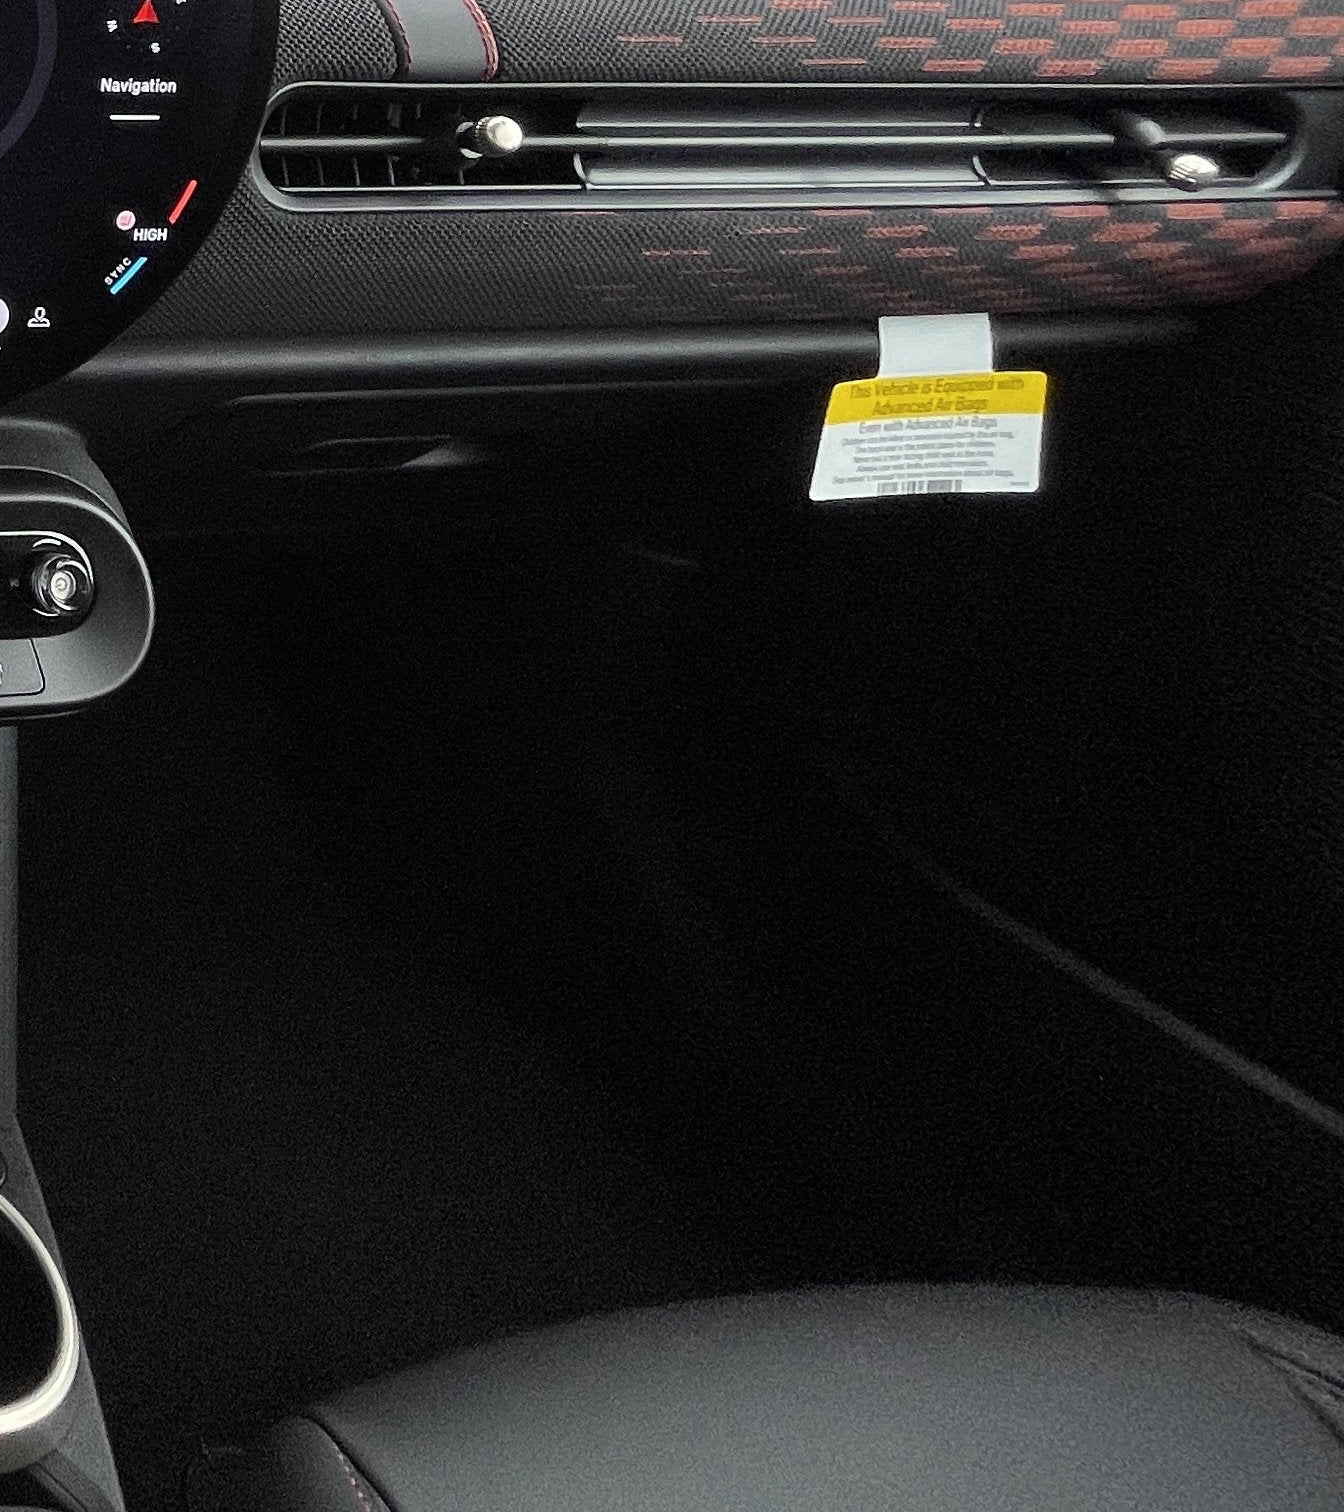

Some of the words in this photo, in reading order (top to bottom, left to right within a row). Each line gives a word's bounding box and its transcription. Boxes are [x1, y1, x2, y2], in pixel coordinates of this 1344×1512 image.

[100, 77, 177, 95] Navigation
[133, 227, 168, 242] HIGH
[104, 257, 132, 286] SYNC
[875, 382, 920, 397] Vehicle
[872, 397, 933, 416] Advanced
[935, 396, 954, 411] Air
